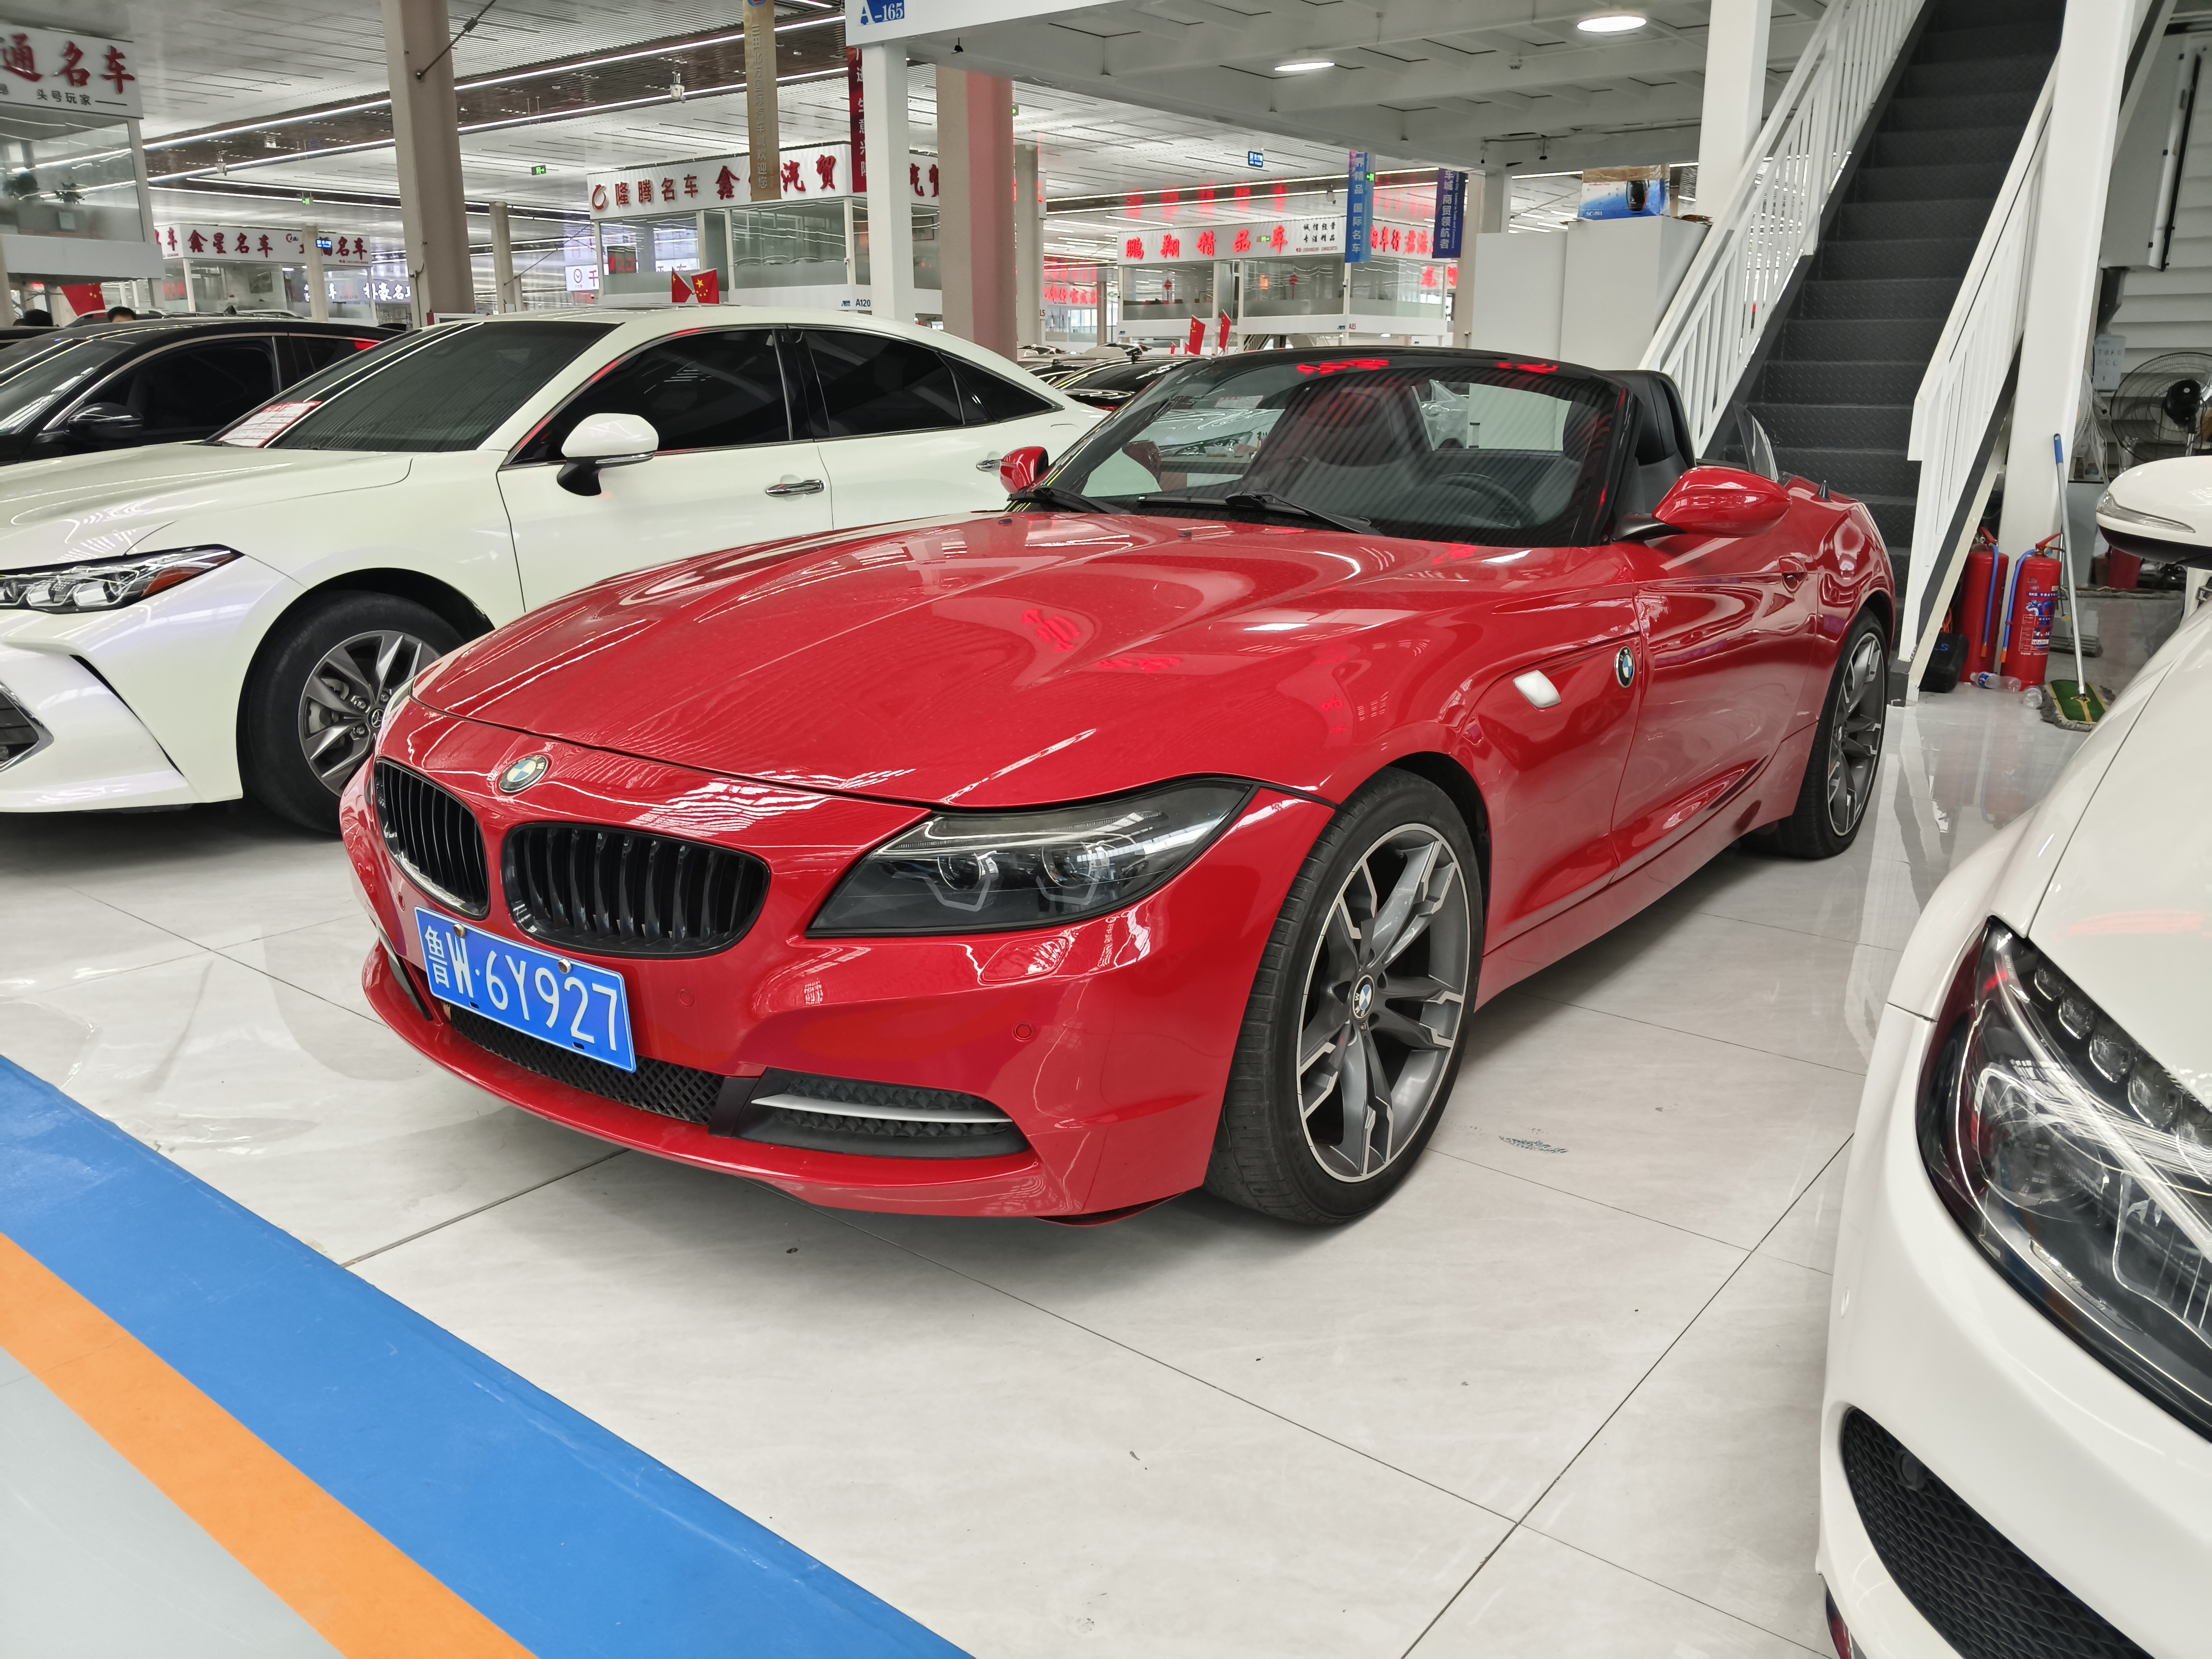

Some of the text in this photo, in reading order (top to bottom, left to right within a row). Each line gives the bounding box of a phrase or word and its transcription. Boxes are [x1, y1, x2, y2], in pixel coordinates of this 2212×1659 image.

[857, 0, 904, 25] A-165
[36, 88, 91, 106] 头号玩家
[715, 155, 836, 200] 鑫汽贸
[1354, 151, 1365, 194] 界精品
[615, 174, 699, 206] 隆腾名车
[188, 229, 273, 258] 鑫星名车
[1125, 224, 1288, 260] 鹏翔精品车
[855, 299, 871, 307] A120
[424, 925, 617, 1052] 鲁W·6Y927
[1354, 992, 1366, 1017] BMW
